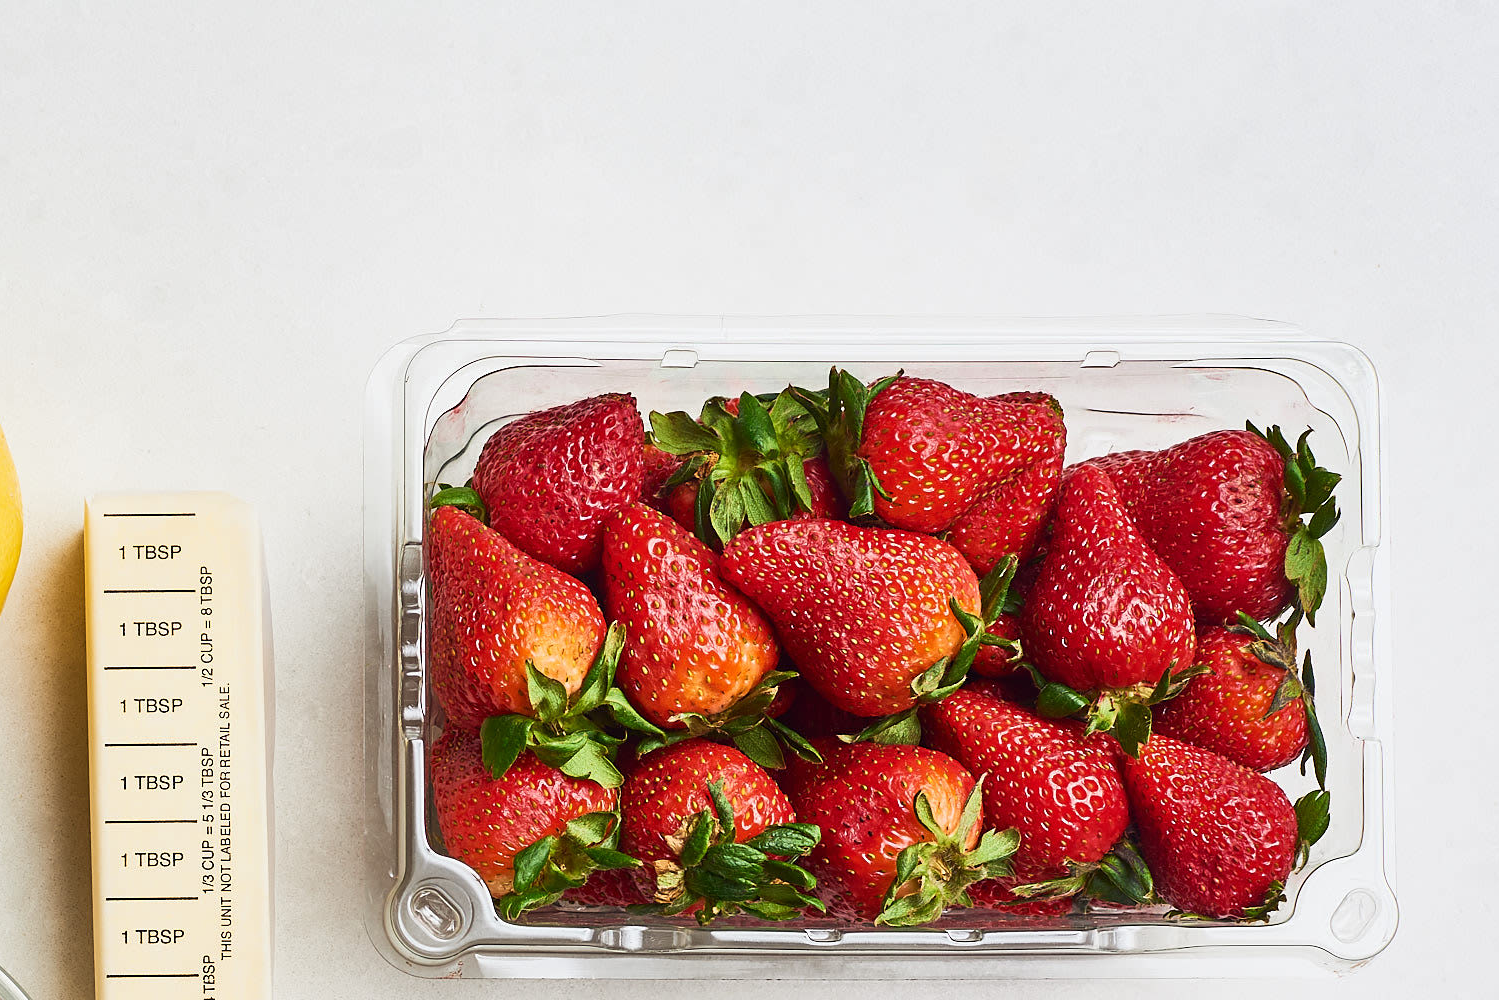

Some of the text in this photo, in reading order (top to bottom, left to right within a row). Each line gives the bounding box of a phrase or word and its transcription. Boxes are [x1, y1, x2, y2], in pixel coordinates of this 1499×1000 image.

[119, 544, 182, 560] 1 TBSP
[200, 566, 213, 605] TBSP
[200, 607, 213, 616] 8
[119, 621, 182, 637] 1 TBSP
[200, 632, 213, 664] CUP
[200, 668, 213, 688] 1/2
[120, 698, 183, 714] 1 TBSP
[201, 747, 214, 788] TBSP
[120, 774, 183, 790] 1 TBSP
[201, 790, 214, 810] 1/3
[201, 814, 214, 823] 5
[219, 682, 231, 961] THIS UNIT NOT LABELED FOR RETAIL SALE.
[120, 851, 184, 867] 1 TBSP
[201, 840, 214, 871] CUP
[201, 874, 214, 895] 1/3
[121, 929, 184, 945] 1 TBSP
[202, 954, 216, 995] TBSP
